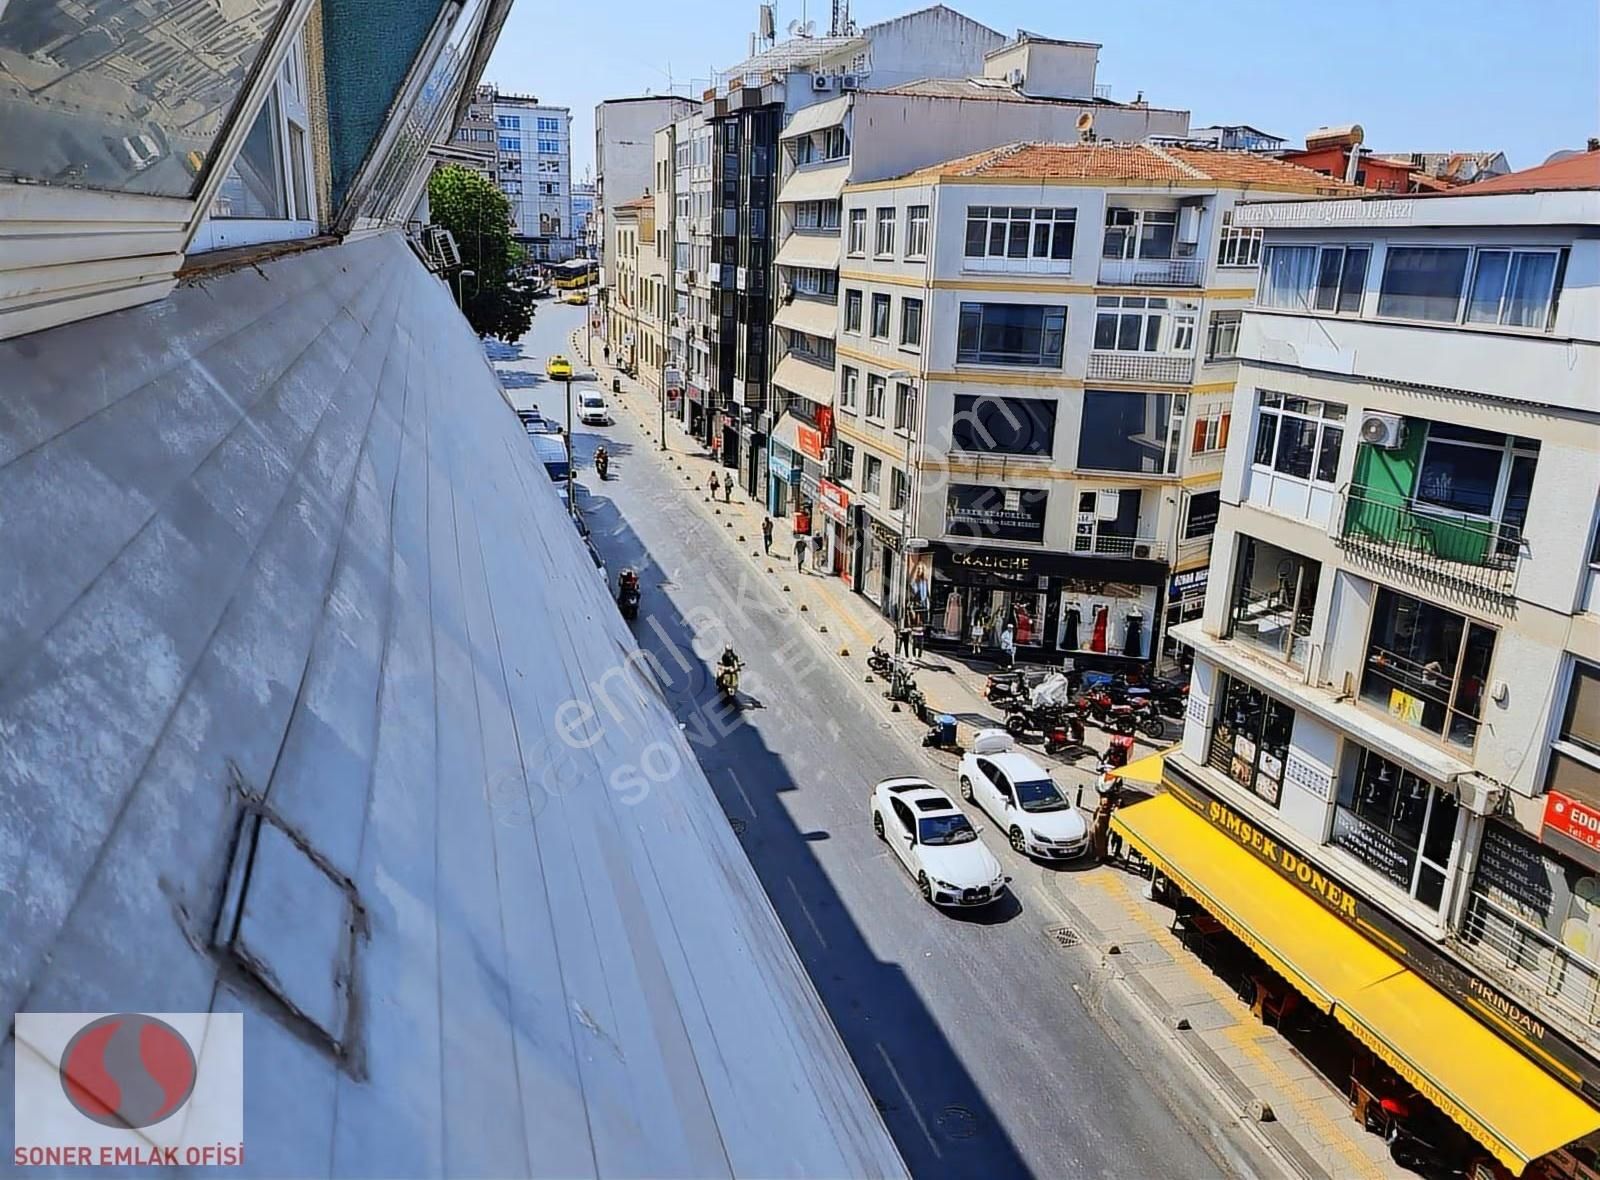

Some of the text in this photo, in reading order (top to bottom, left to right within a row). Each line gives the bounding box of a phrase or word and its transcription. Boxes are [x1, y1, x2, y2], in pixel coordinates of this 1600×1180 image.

[1570, 808, 1600, 834] EDO
[1208, 800, 1278, 862] ŞİMŞEK
[1281, 848, 1358, 918] DÖNER
[1469, 977, 1545, 1040] FIRINDAN
